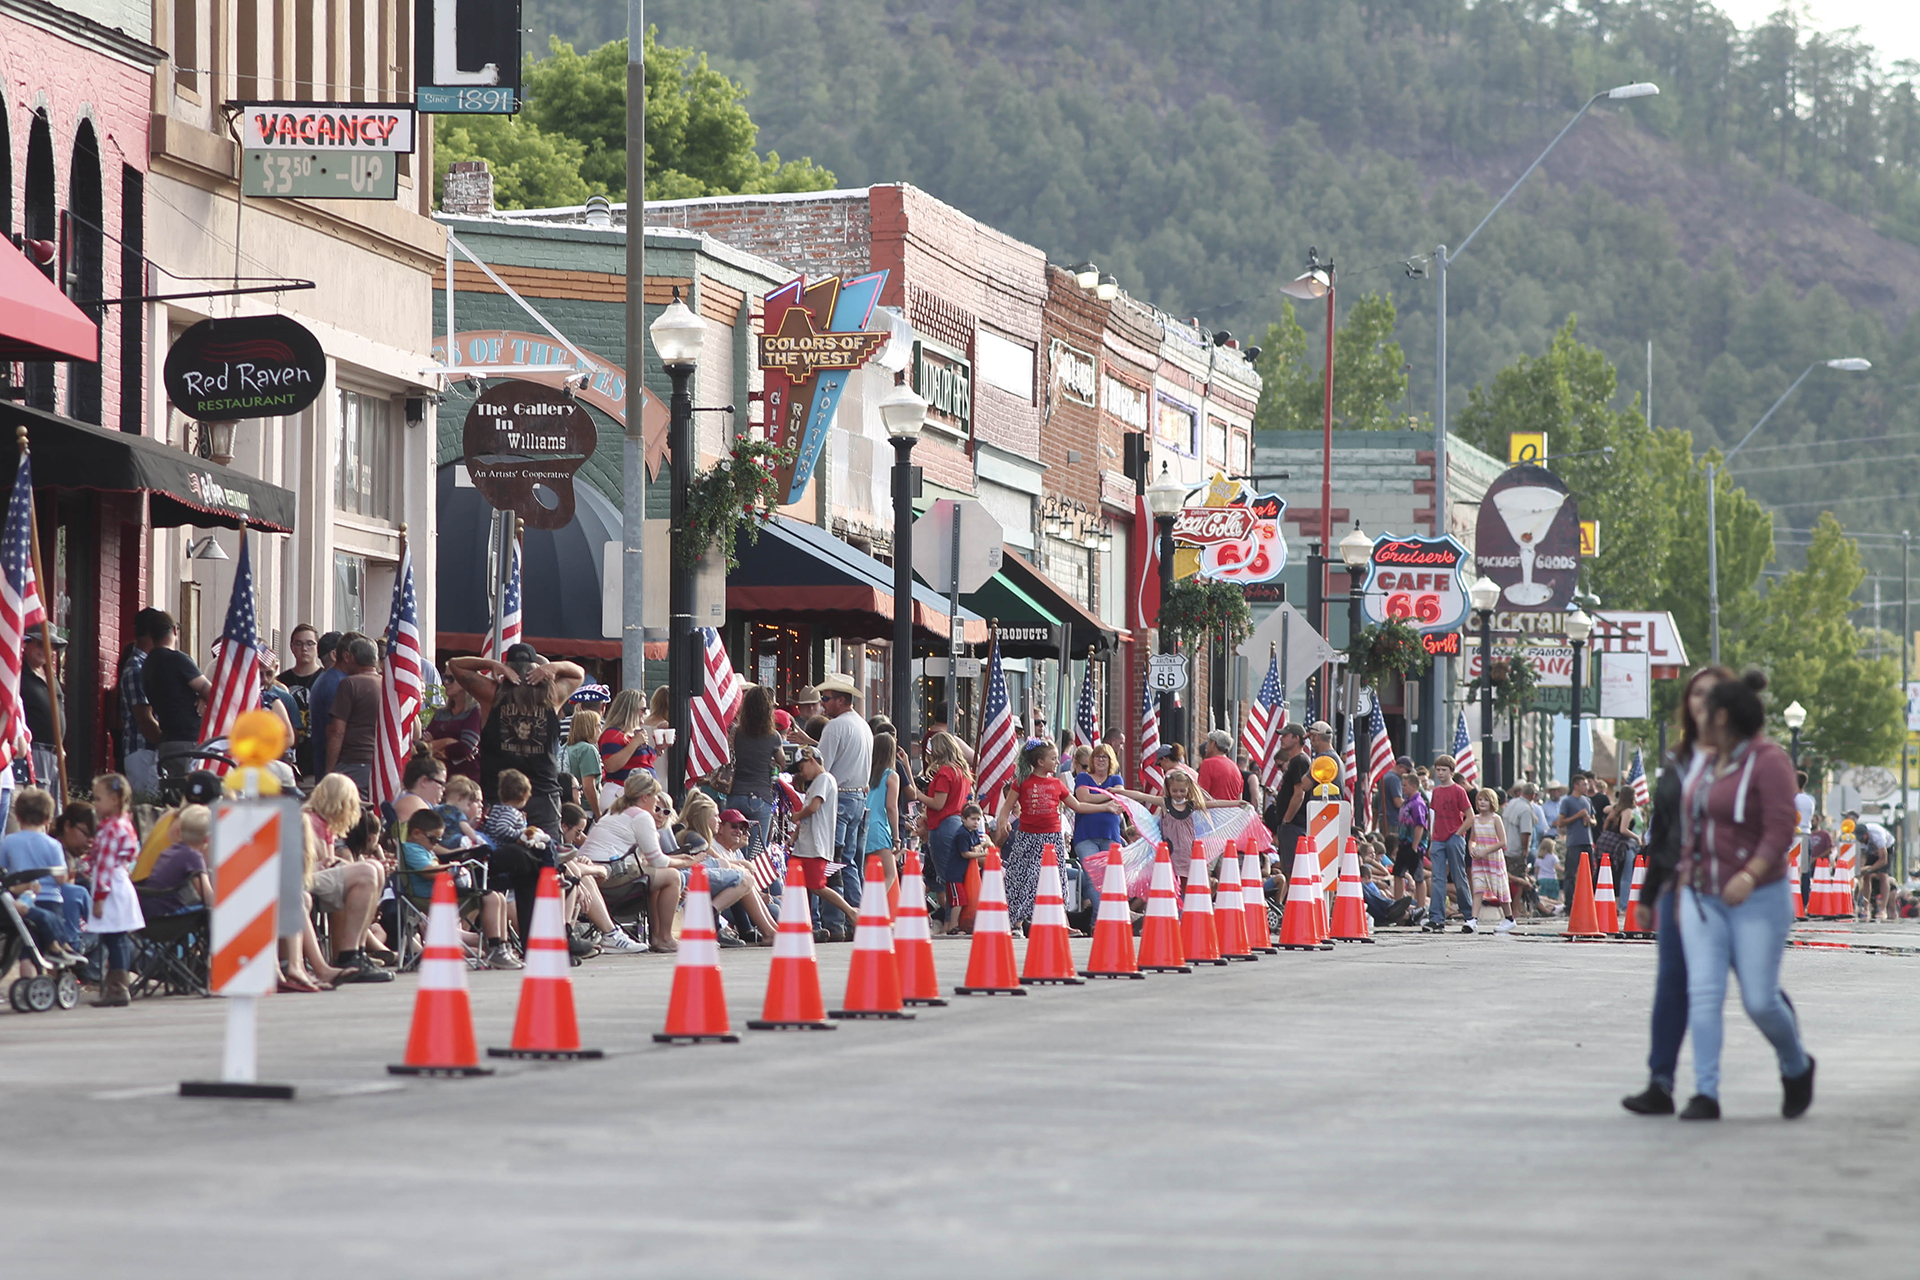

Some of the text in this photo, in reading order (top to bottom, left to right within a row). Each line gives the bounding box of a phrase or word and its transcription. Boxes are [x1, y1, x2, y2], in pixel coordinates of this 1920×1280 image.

[424, 89, 508, 112] Since 1891
[254, 112, 399, 147] VACANCY
[468, 337, 503, 365] OF
[510, 338, 568, 366] THE
[764, 336, 865, 351] COLORS OF
[765, 351, 852, 365] THE WEST
[183, 361, 312, 397] Red Raven
[197, 393, 296, 411] RESTAURANT
[475, 403, 577, 416] The Gallery
[495, 418, 514, 430] In
[507, 433, 567, 450] Williams
[786, 402, 804, 465] RUGS
[792, 380, 838, 490] POTTERY
[474, 469, 570, 479] An Artists' Cooperative
[1212, 485, 1231, 499] COLD
[1218, 481, 1231, 492] ICE
[1217, 544, 1270, 575] 66
[1535, 555, 1577, 570] GOODS
[1377, 572, 1450, 592] CAFE
[1244, 584, 1280, 601] Shop
[1385, 593, 1442, 625] 66
[996, 628, 1048, 640] PRODUCTS
[1422, 633, 1459, 655] Grill
[1528, 647, 1573, 657] FAMOU
[1157, 673, 1175, 686] 66
